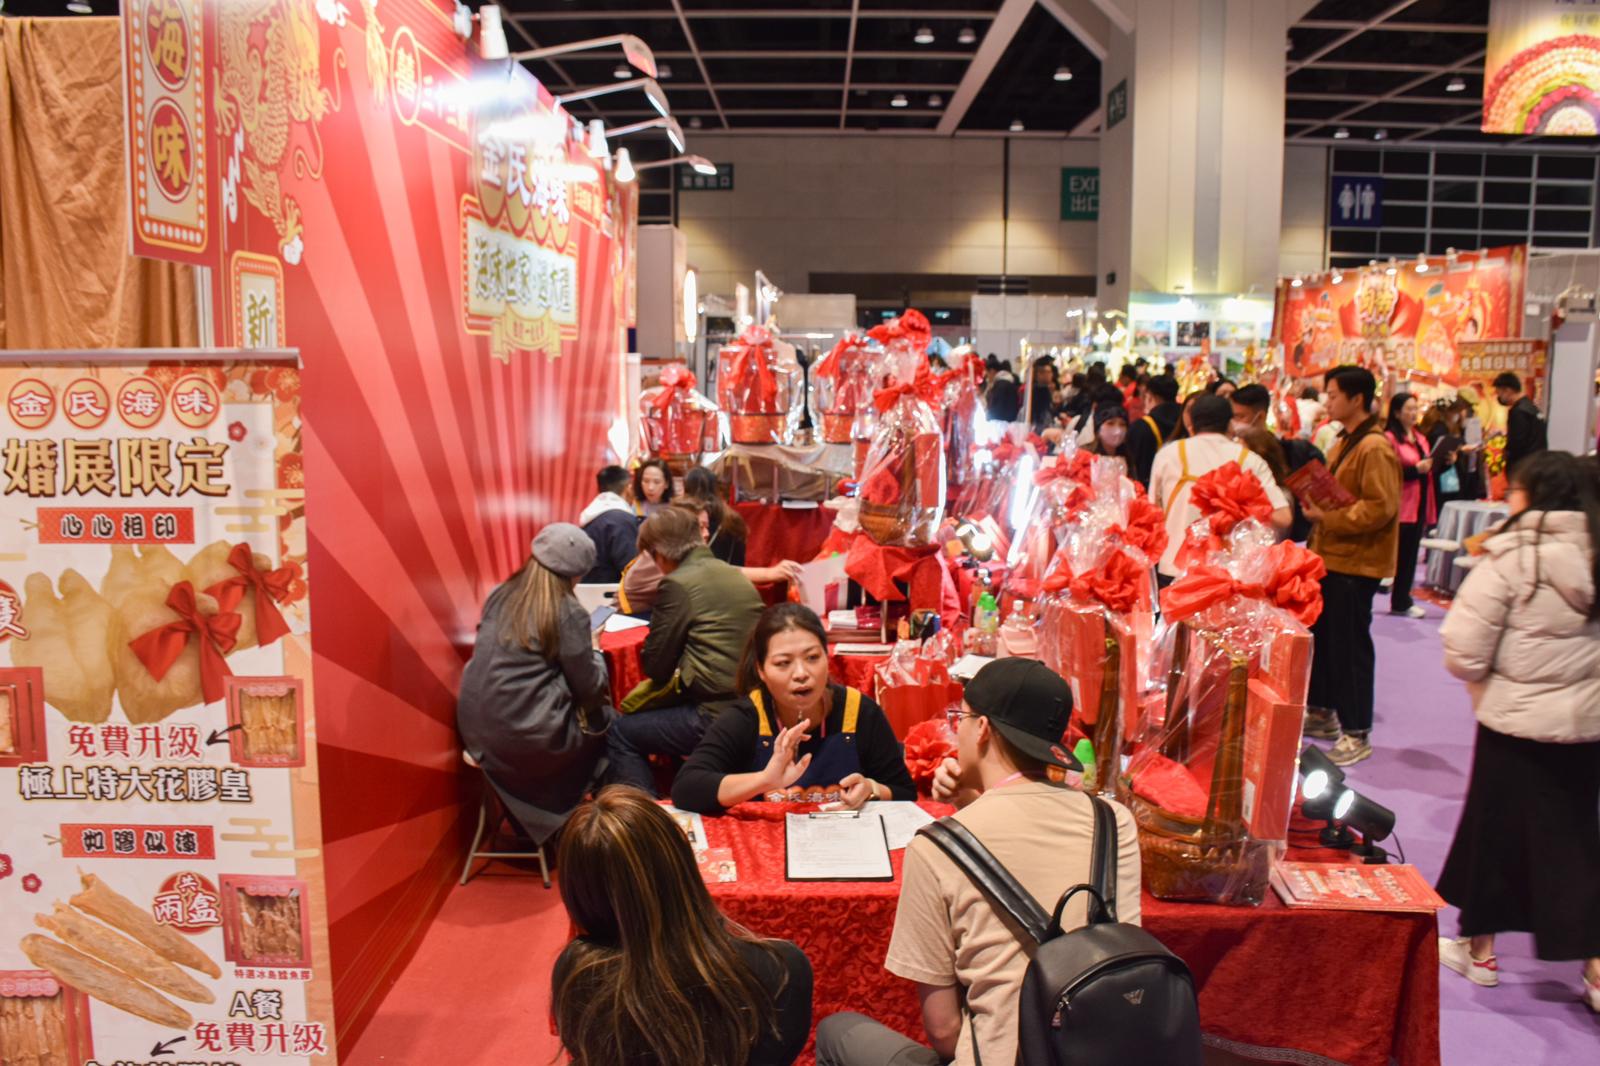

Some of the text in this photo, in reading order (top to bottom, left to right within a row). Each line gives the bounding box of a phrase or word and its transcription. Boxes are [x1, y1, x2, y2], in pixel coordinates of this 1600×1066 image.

[11, 387, 214, 419] 金氏海味
[2, 437, 231, 497] 婚展限定
[61, 513, 178, 539] 心心相印
[68, 724, 201, 759] 免費升級
[19, 766, 251, 802] 極上特大花膠皇
[83, 830, 198, 853] 如膠似漆
[177, 873, 199, 893] 共
[155, 893, 219, 924] 兩盒
[228, 988, 282, 1020] A餐
[194, 1022, 325, 1054] 免費升級
